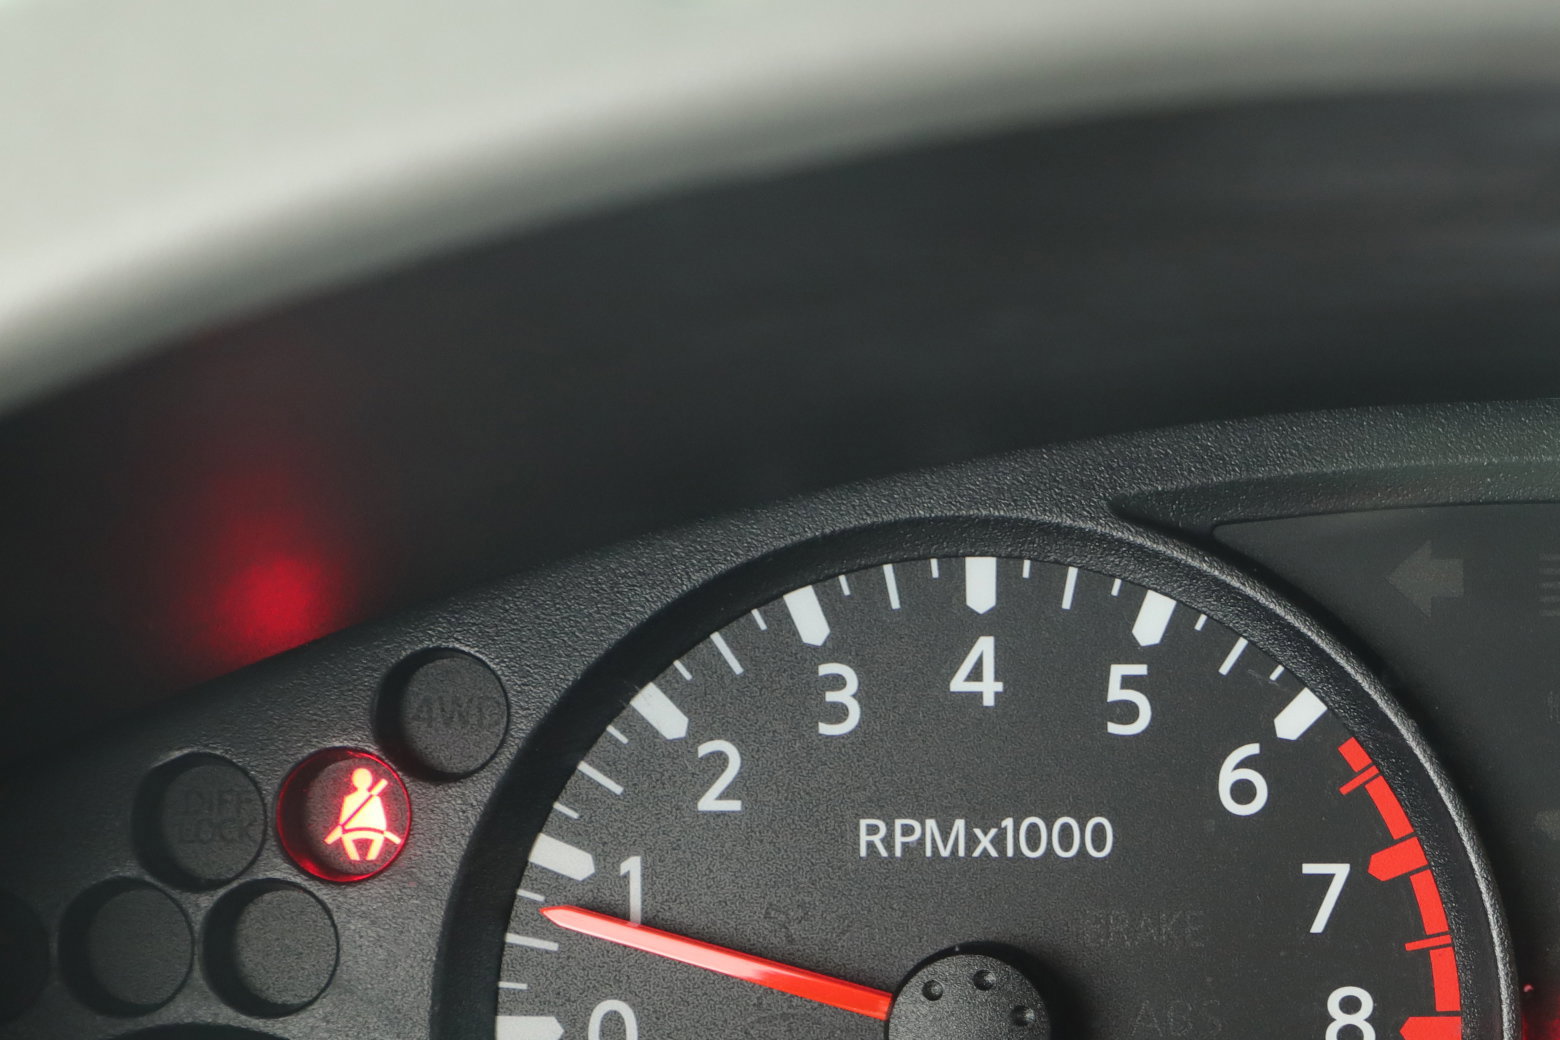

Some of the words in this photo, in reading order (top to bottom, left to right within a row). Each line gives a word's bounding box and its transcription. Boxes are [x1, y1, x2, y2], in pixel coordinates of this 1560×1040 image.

[817, 662, 861, 736] 3
[949, 636, 1004, 707] 4
[1106, 664, 1152, 736] 5
[697, 739, 742, 812] 2
[1218, 743, 1268, 816] 6
[858, 816, 1114, 858] RPMx1000
[620, 856, 642, 924] 1
[1302, 863, 1351, 934] 7
